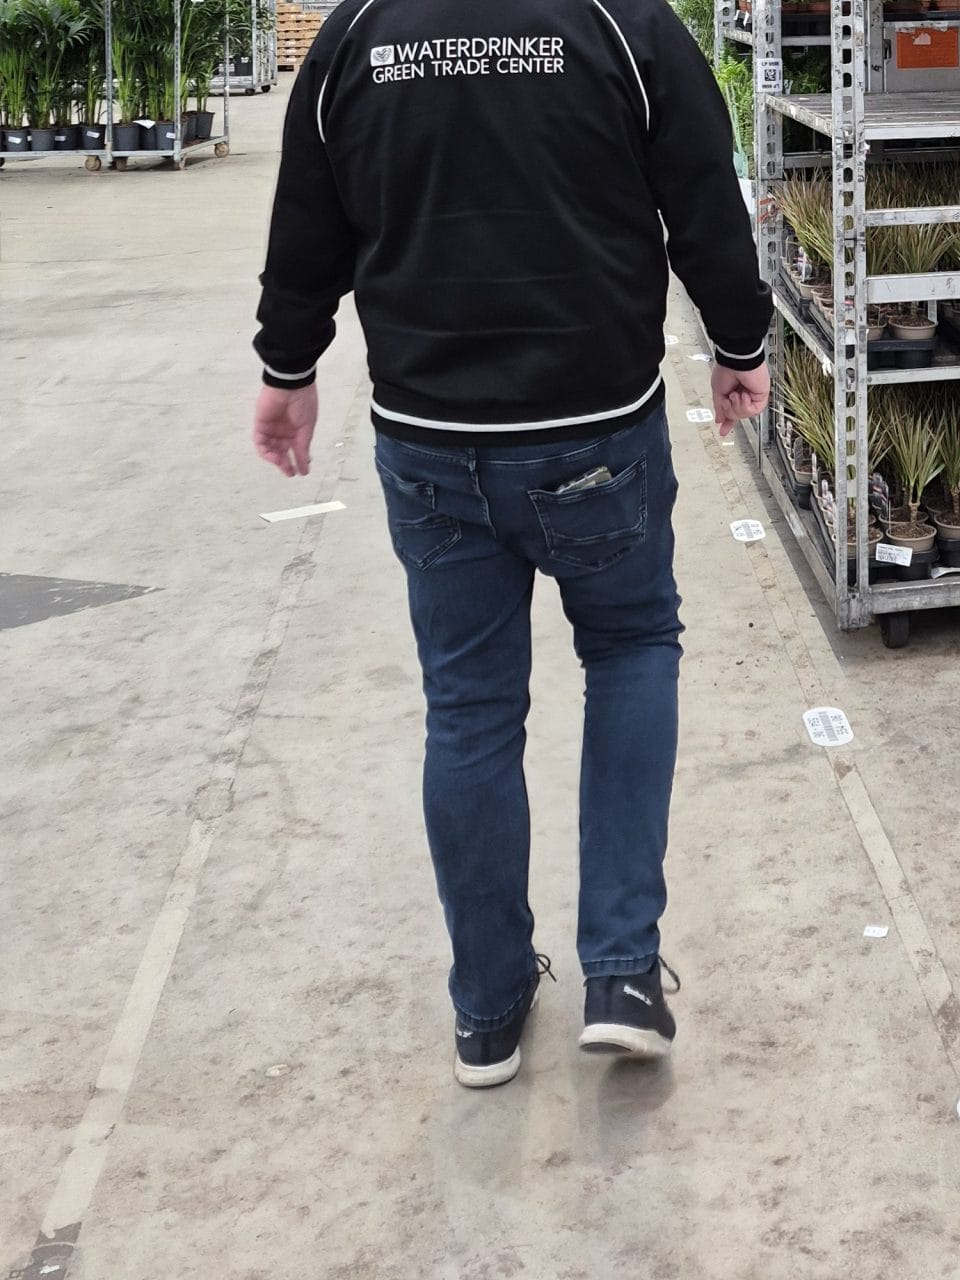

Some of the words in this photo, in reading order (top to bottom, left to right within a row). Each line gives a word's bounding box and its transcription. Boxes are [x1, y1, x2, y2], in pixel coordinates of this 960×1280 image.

[396, 37, 565, 63] WATERDRINKER
[372, 62, 425, 84] GREEN
[431, 58, 490, 77] TRADE
[496, 57, 565, 74] CENTER
